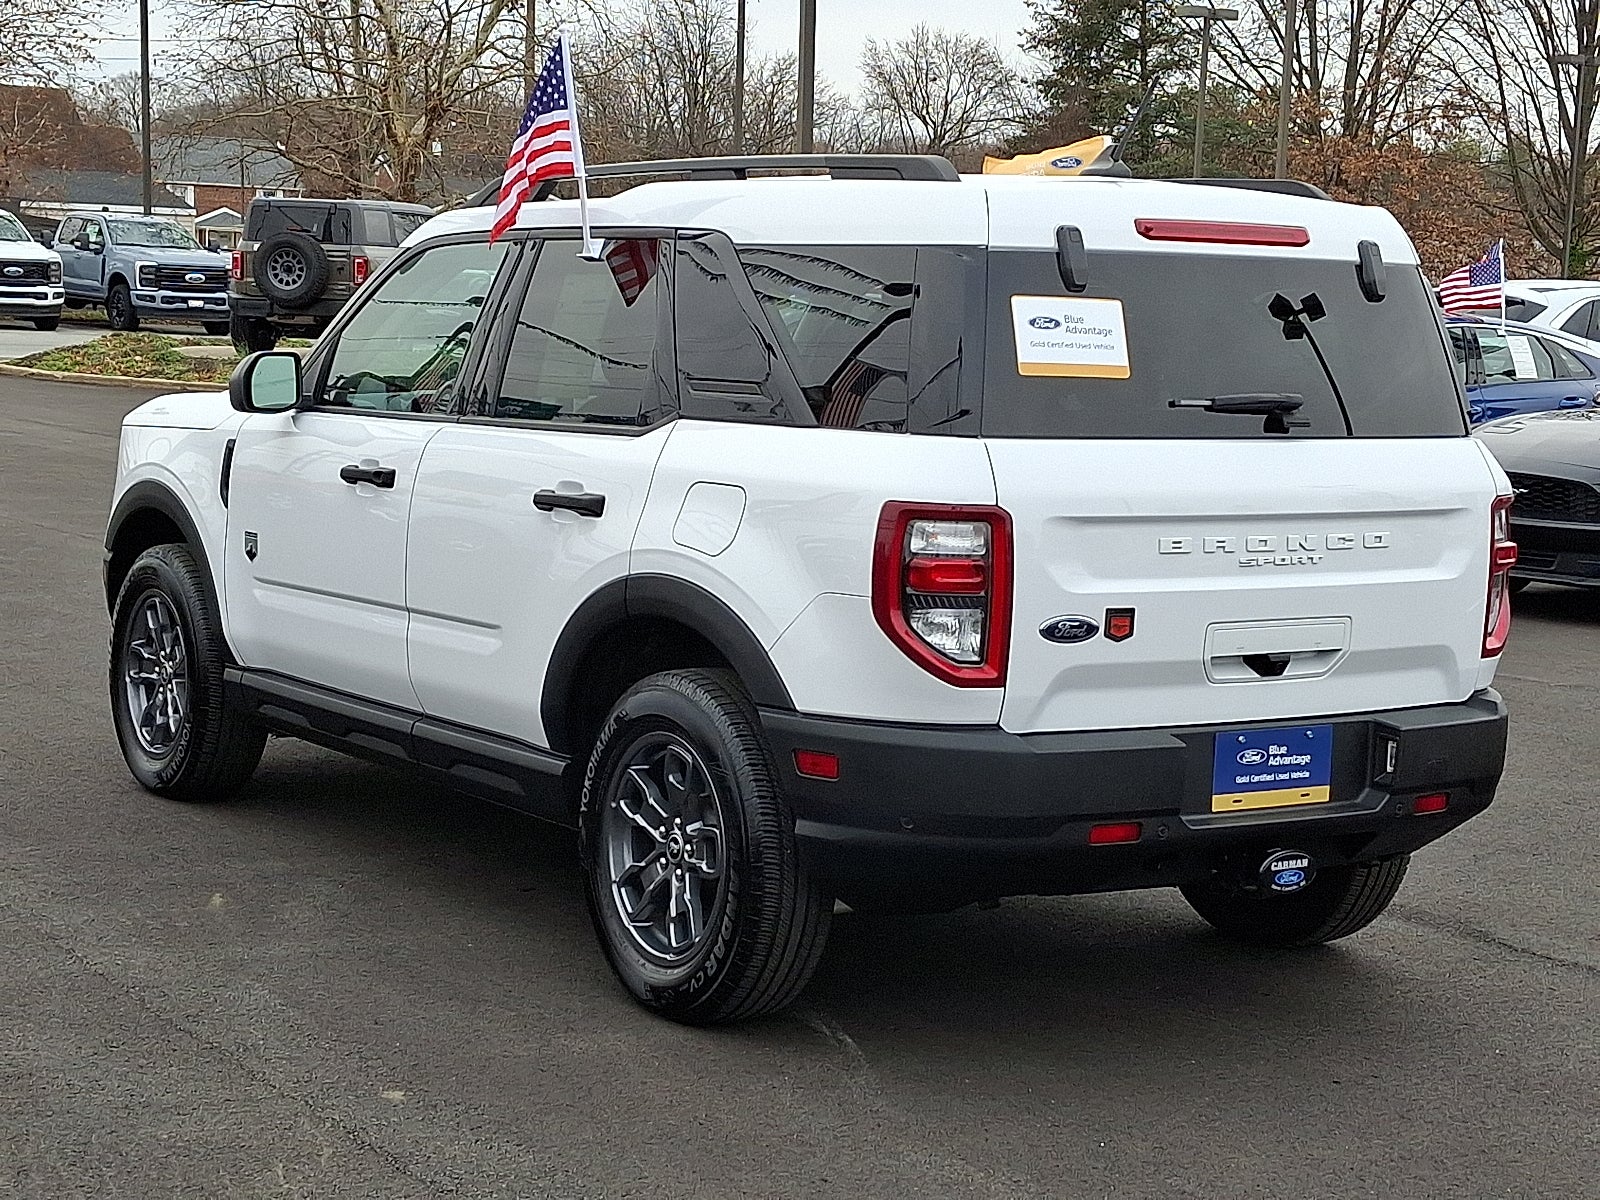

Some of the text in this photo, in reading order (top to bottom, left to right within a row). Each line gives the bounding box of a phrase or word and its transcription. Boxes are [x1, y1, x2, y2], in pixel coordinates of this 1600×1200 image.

[1034, 317, 1056, 328] Ford
[1064, 314, 1084, 324] Blue
[1065, 325, 1113, 337] Advantage
[1030, 340, 1115, 351] Gold Certified Used Vehicle
[1158, 531, 1391, 554] BRONCO
[1238, 554, 1324, 567] SPORT
[1054, 621, 1088, 637] Ford
[161, 722, 192, 782] YOKOHAMA
[1268, 744, 1288, 755] Blue
[1242, 751, 1262, 763] Ford
[1268, 754, 1312, 766] Advantage
[579, 718, 618, 812] YOKOHAMA
[1235, 770, 1310, 783] Gold Certified Used Vehicle
[1270, 858, 1309, 871] CARMAN
[1280, 872, 1299, 883] Ford
